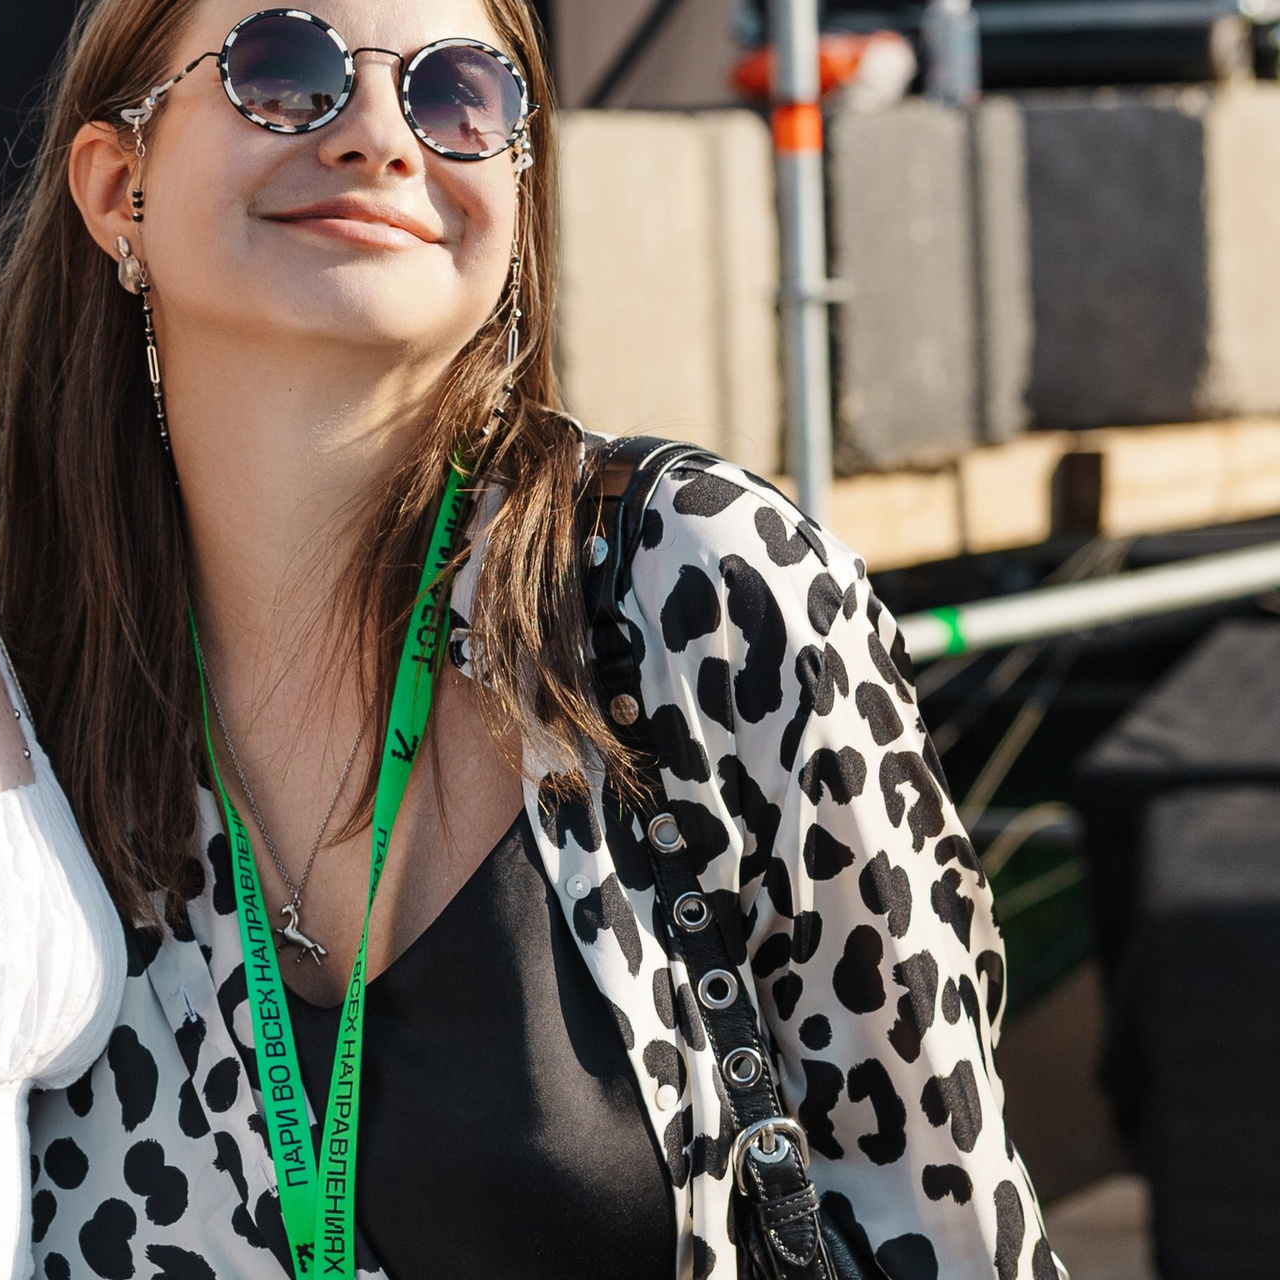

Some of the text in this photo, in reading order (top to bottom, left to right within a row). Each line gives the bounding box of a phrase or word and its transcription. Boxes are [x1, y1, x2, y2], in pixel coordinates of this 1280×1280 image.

[228, 797, 309, 1188] ПАРИ ВО ВСЕХ НАПРАВЛЕНИ
[345, 960, 362, 1032] ВСЕХ
[323, 1039, 356, 1275] НАПРАВЛЕНИЯХ
